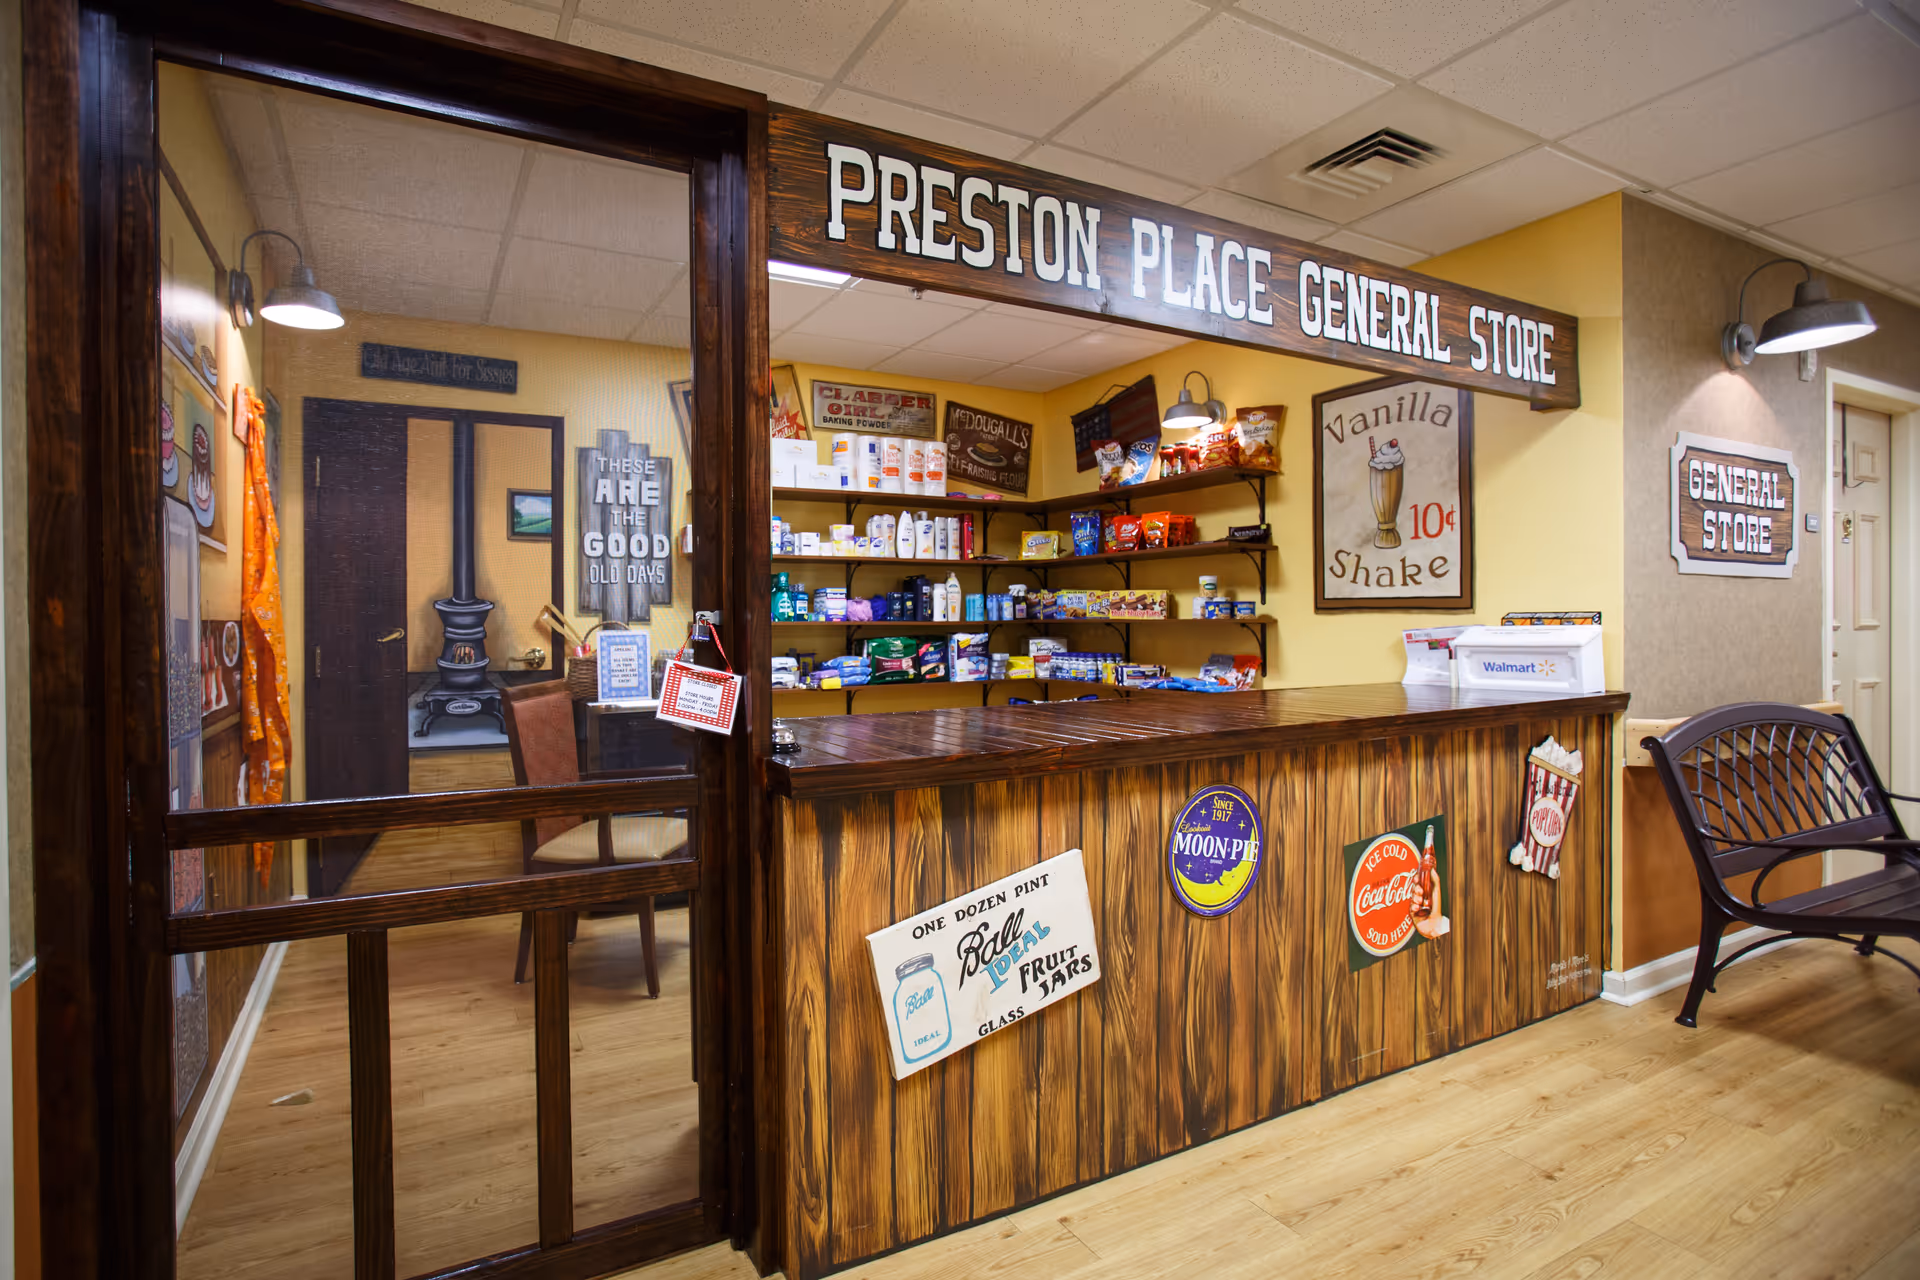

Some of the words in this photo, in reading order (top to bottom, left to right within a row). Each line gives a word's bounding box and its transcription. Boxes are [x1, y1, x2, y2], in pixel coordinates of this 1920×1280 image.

[826, 142, 1101, 290] PRESTON
[1131, 217, 1274, 326] PLACE
[1299, 260, 1451, 363] GENERAL
[1469, 305, 1556, 385] STORE
[818, 384, 933, 409] CLABBER
[827, 402, 885, 419] GIRL
[822, 415, 853, 427] BAKING
[856, 416, 893, 430] POWDER
[1325, 391, 1453, 444] Vanilla
[597, 457, 655, 475] THESE
[594, 478, 660, 507] ARE
[1688, 458, 1786, 511] GENERAL
[611, 510, 647, 527] THE
[1409, 502, 1457, 541] 10¢
[1702, 509, 1773, 555] STORE
[583, 532, 671, 560] GOOD
[590, 564, 619, 585] OLD
[627, 565, 665, 585] DAYS
[1329, 548, 1450, 588] Shake
[1483, 661, 1536, 674] Walmart
[685, 690, 698, 698] STORE
[699, 694, 714, 702] HOURS
[687, 678, 700, 686] STORE
[701, 682, 718, 690] CLOSED
[679, 696, 698, 704] MONDAY
[702, 701, 718, 709] FRIDAY
[1211, 809, 1232, 823] 1917
[1212, 797, 1234, 811] SINCE
[1180, 822, 1212, 834] Lookout
[1532, 806, 1562, 837] POPCORN
[1364, 850, 1383, 873] ICE
[1383, 843, 1408, 861] COLD
[912, 916, 947, 940] ONE
[954, 891, 1007, 922] DOZEN
[1014, 873, 1050, 898] PINT
[1366, 927, 1389, 946] SOLD
[1390, 914, 1413, 944] HERE
[956, 907, 1026, 992] Ball
[979, 920, 1051, 995] IDEAL
[1018, 944, 1078, 995] FRUIT
[1037, 953, 1093, 1002] JARS
[904, 985, 935, 1021] Ball
[978, 1006, 1025, 1038] GLASS
[913, 1029, 941, 1048] IDEAL
